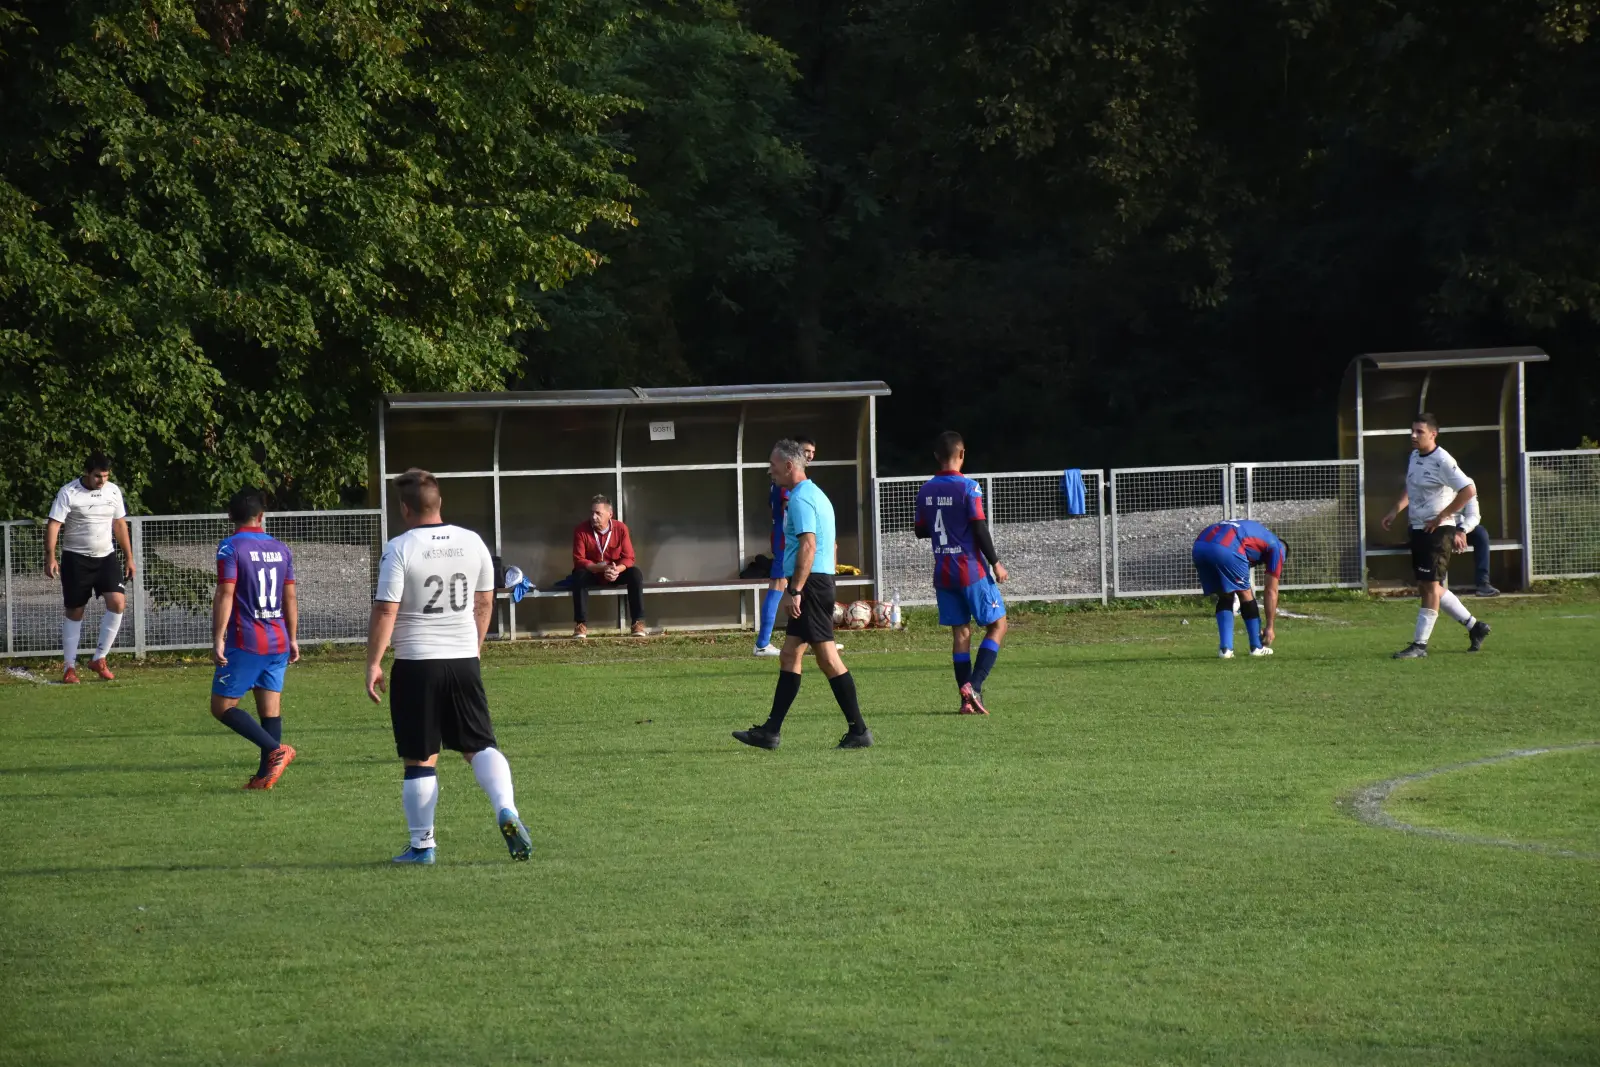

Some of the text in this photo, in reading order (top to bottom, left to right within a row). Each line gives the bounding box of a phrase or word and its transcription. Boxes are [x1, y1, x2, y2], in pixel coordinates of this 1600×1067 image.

[934, 509, 948, 545] 4
[258, 567, 277, 608] 11
[423, 572, 468, 614] 20
